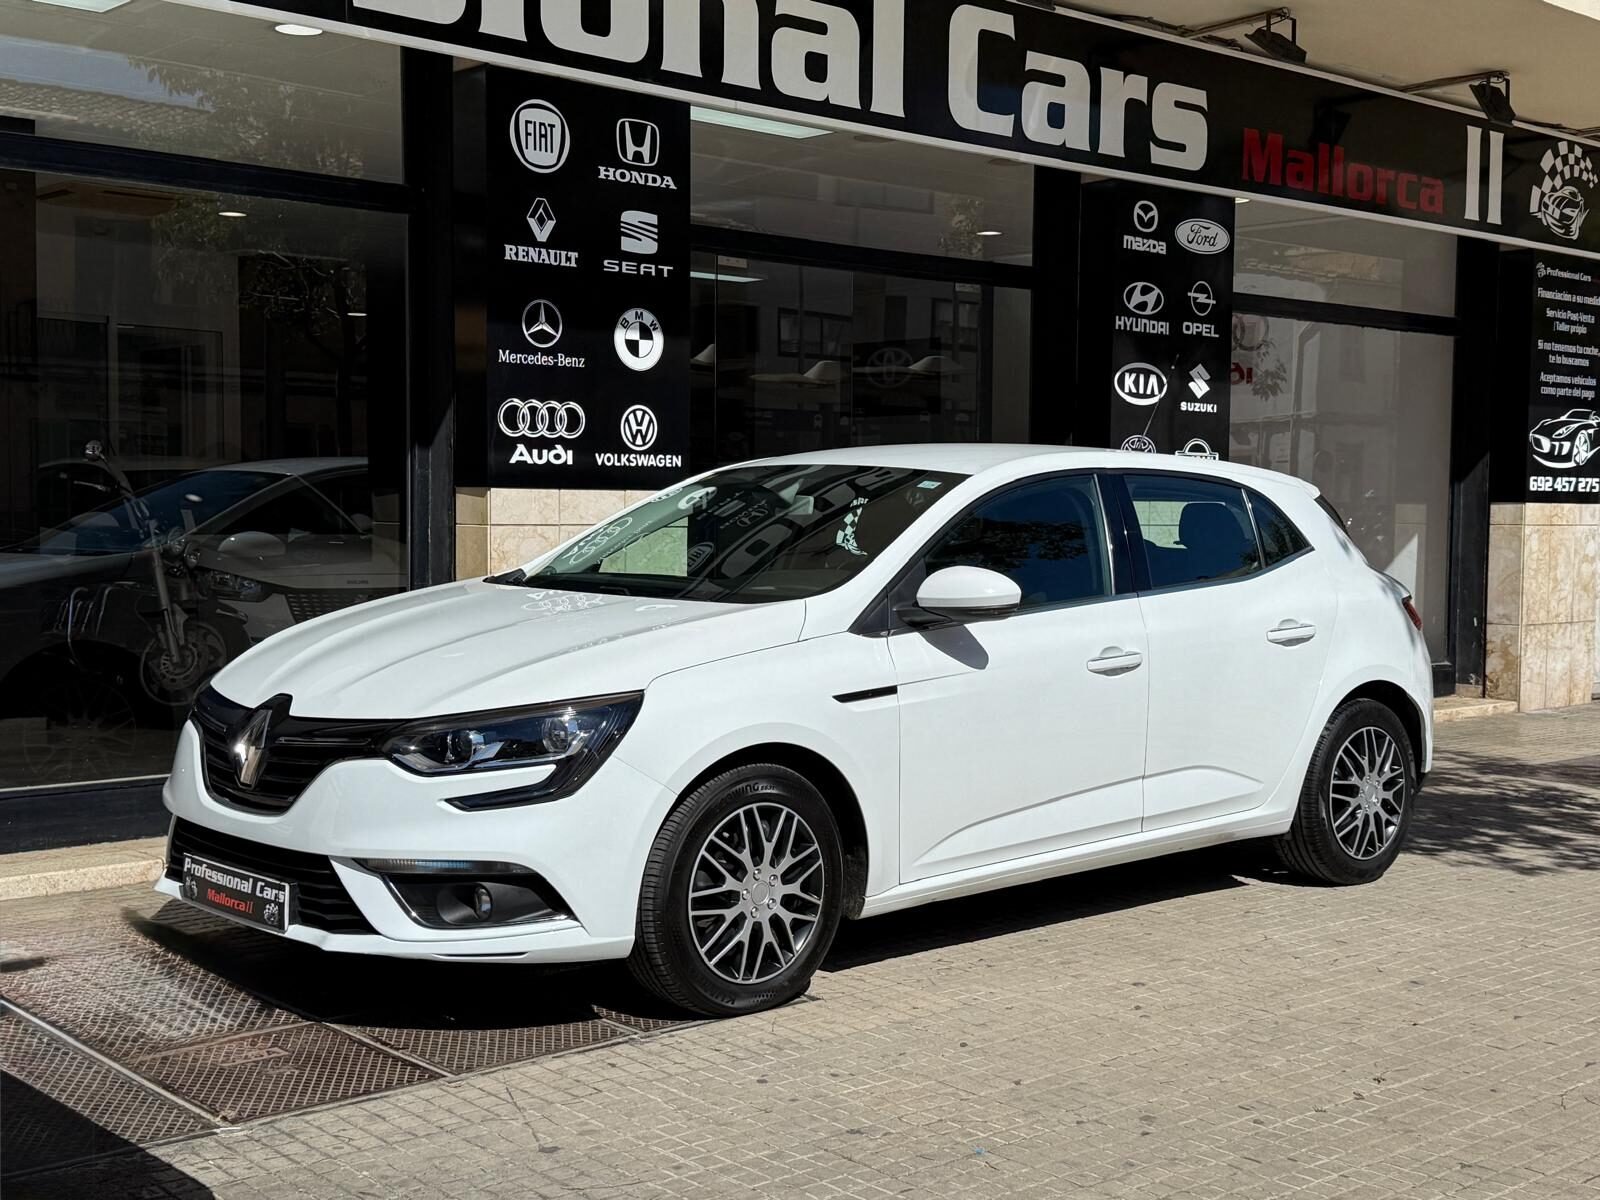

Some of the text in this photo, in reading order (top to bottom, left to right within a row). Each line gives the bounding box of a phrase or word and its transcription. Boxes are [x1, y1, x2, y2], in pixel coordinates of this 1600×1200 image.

[947, 3, 1209, 172] Cars
[525, 120, 556, 153] FIAT
[598, 166, 677, 190] HONDA
[1242, 128, 1444, 215] Mallorca
[1186, 223, 1219, 248] Ford
[504, 244, 579, 268] RENAULT
[603, 260, 674, 278] SEAT
[1547, 267, 1592, 282] Professional Cars
[620, 310, 660, 332] BMW
[1546, 307, 1567, 319] Servicio
[1115, 315, 1170, 336] HYUNDAI
[1183, 321, 1220, 338] OPEL
[1544, 342, 1551, 351] no
[1551, 341, 1577, 353] tenemos
[1577, 344, 1583, 354] tu
[498, 349, 585, 368] Mercedes-Benz
[1549, 353, 1590, 367] te lo buscamos
[1124, 372, 1160, 396] KIA
[1540, 371, 1571, 385] Aceptamos
[1540, 386, 1596, 400] como parte del pago
[1180, 401, 1218, 413] SUZUKI
[509, 444, 574, 465] Audi
[595, 453, 682, 468] VOLKSWAGEN
[1529, 476, 1600, 493] 692 457 275
[184, 857, 286, 903] Professional Cars
[207, 888, 246, 911] Mallorca
